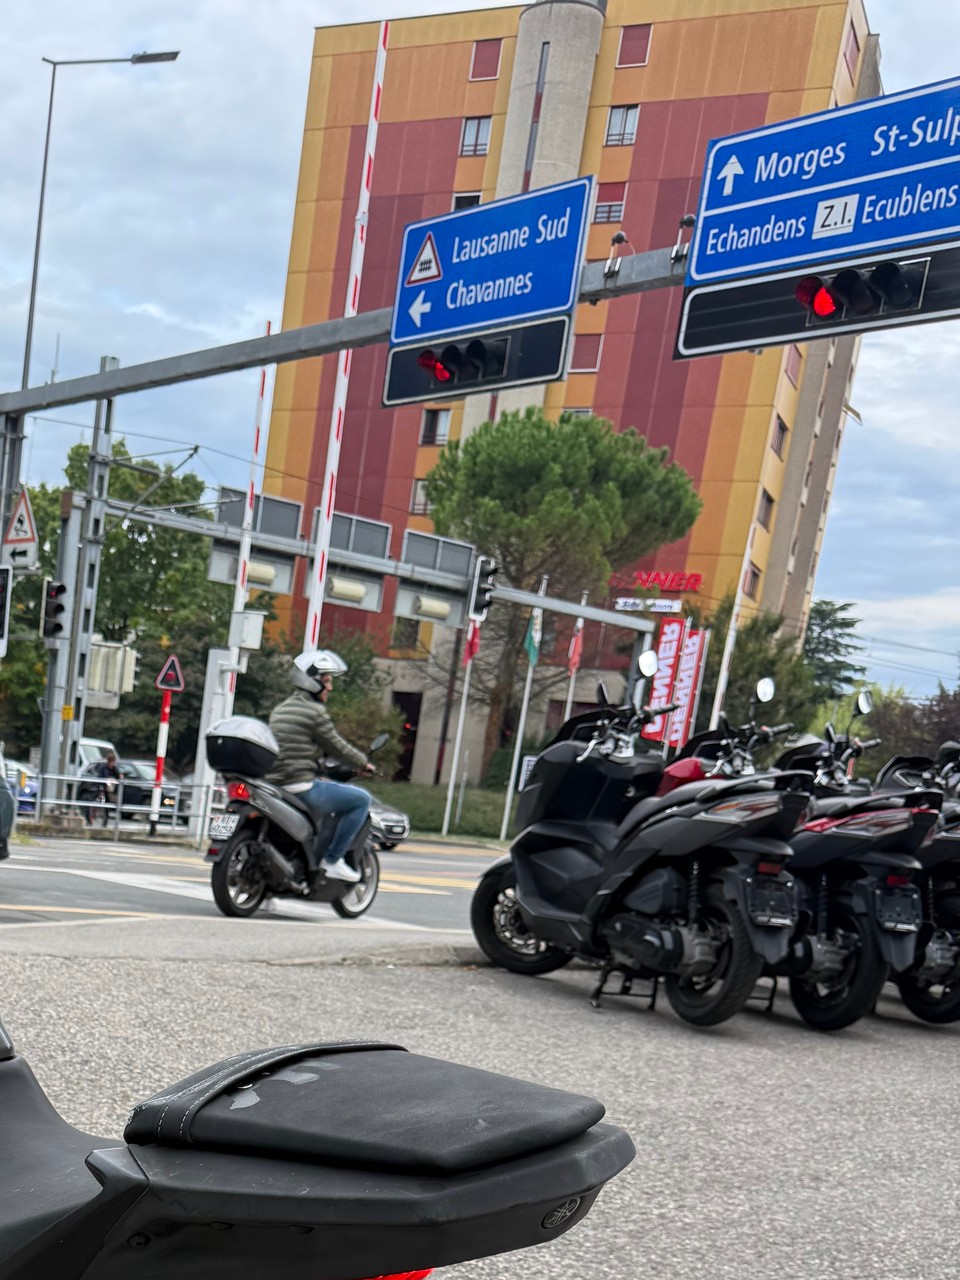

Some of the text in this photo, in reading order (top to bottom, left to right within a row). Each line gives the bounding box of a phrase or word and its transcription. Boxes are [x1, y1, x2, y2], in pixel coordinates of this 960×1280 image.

[754, 141, 847, 184] Morges
[452, 206, 571, 264] Lausanne Sud
[706, 183, 959, 255] Echandens Z.I. Ecublens
[446, 272, 533, 309] Chavannes
[608, 571, 703, 591] NNER
